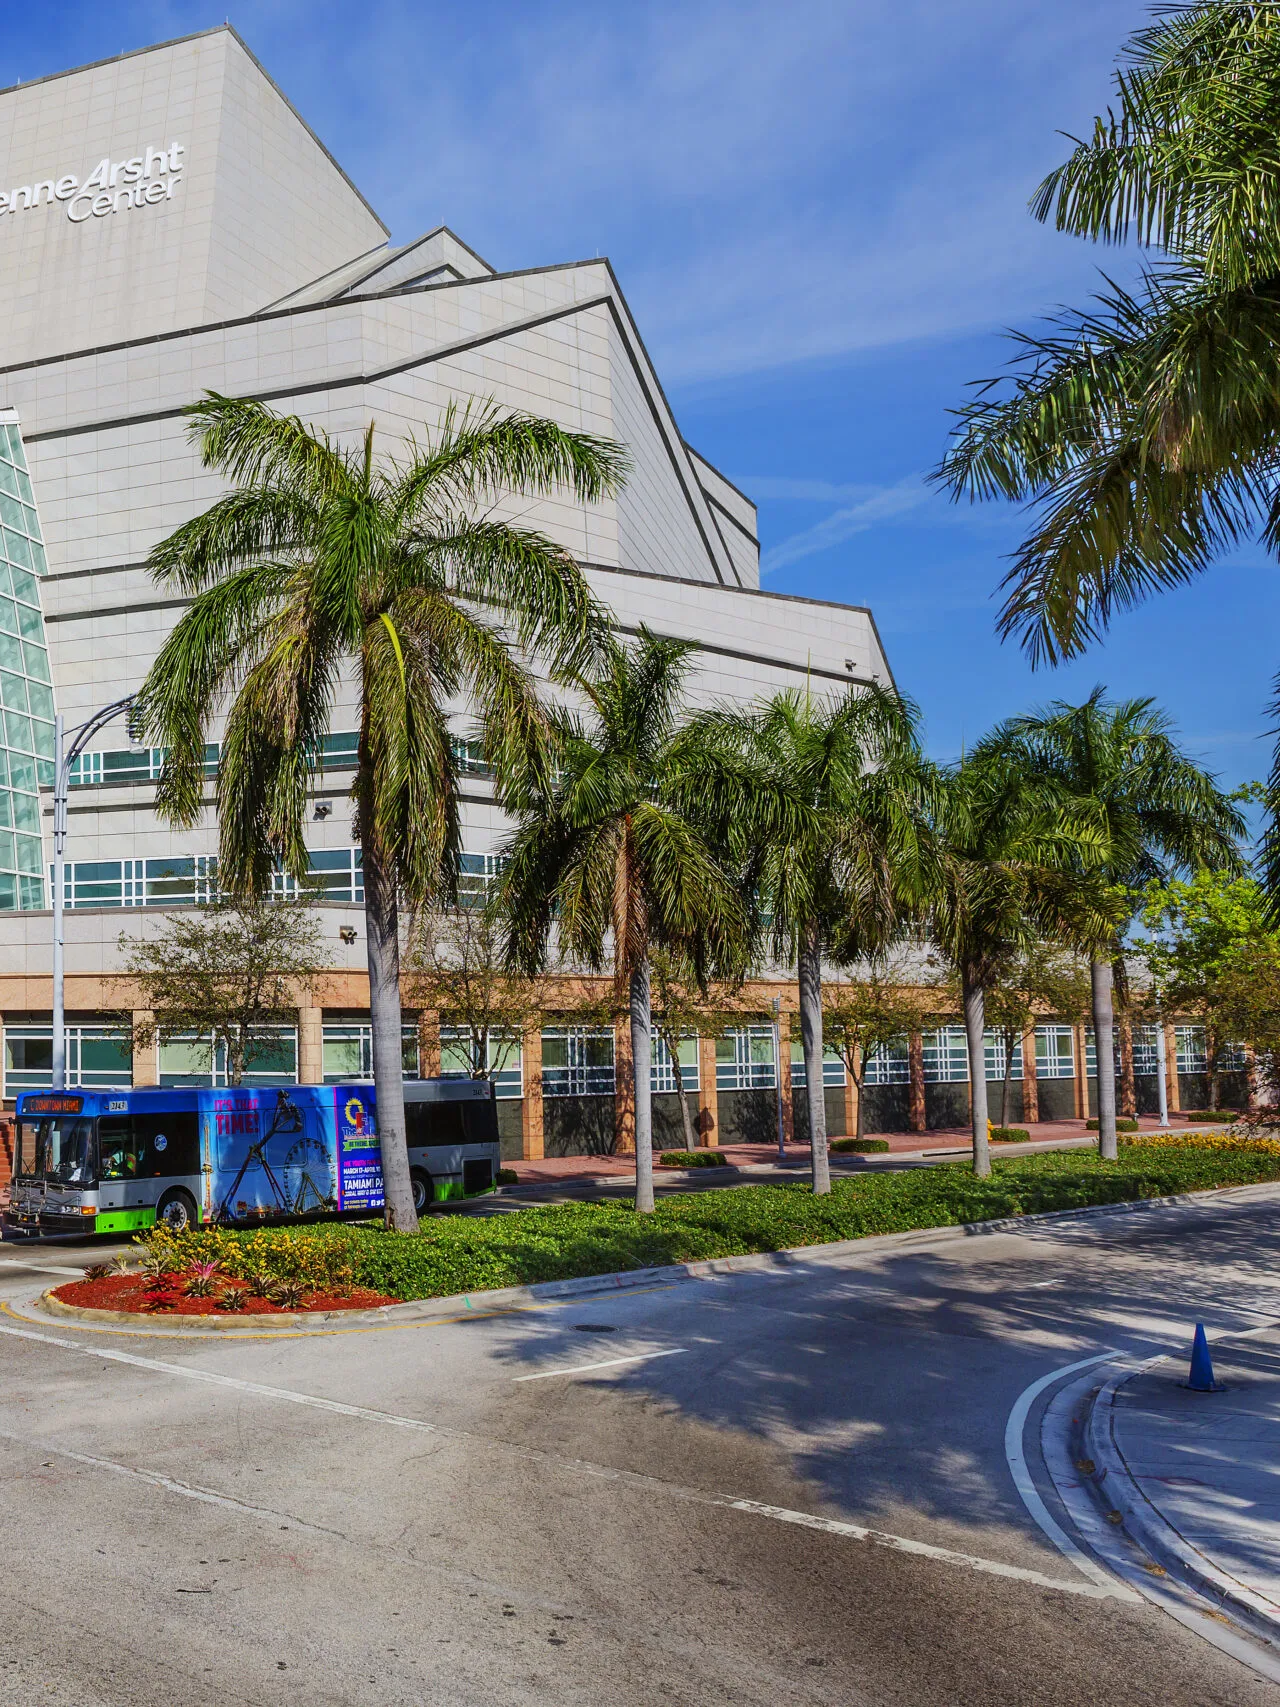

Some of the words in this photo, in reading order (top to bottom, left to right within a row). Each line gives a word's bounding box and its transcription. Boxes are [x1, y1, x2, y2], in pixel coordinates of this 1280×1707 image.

[76, 142, 185, 194] Arsht
[67, 174, 182, 223] Center
[35, 1099, 62, 1111] DOWNTOWN
[214, 1099, 233, 1111] IT'S
[235, 1098, 258, 1110] THAT
[344, 1179, 374, 1190] TAMIAMI
